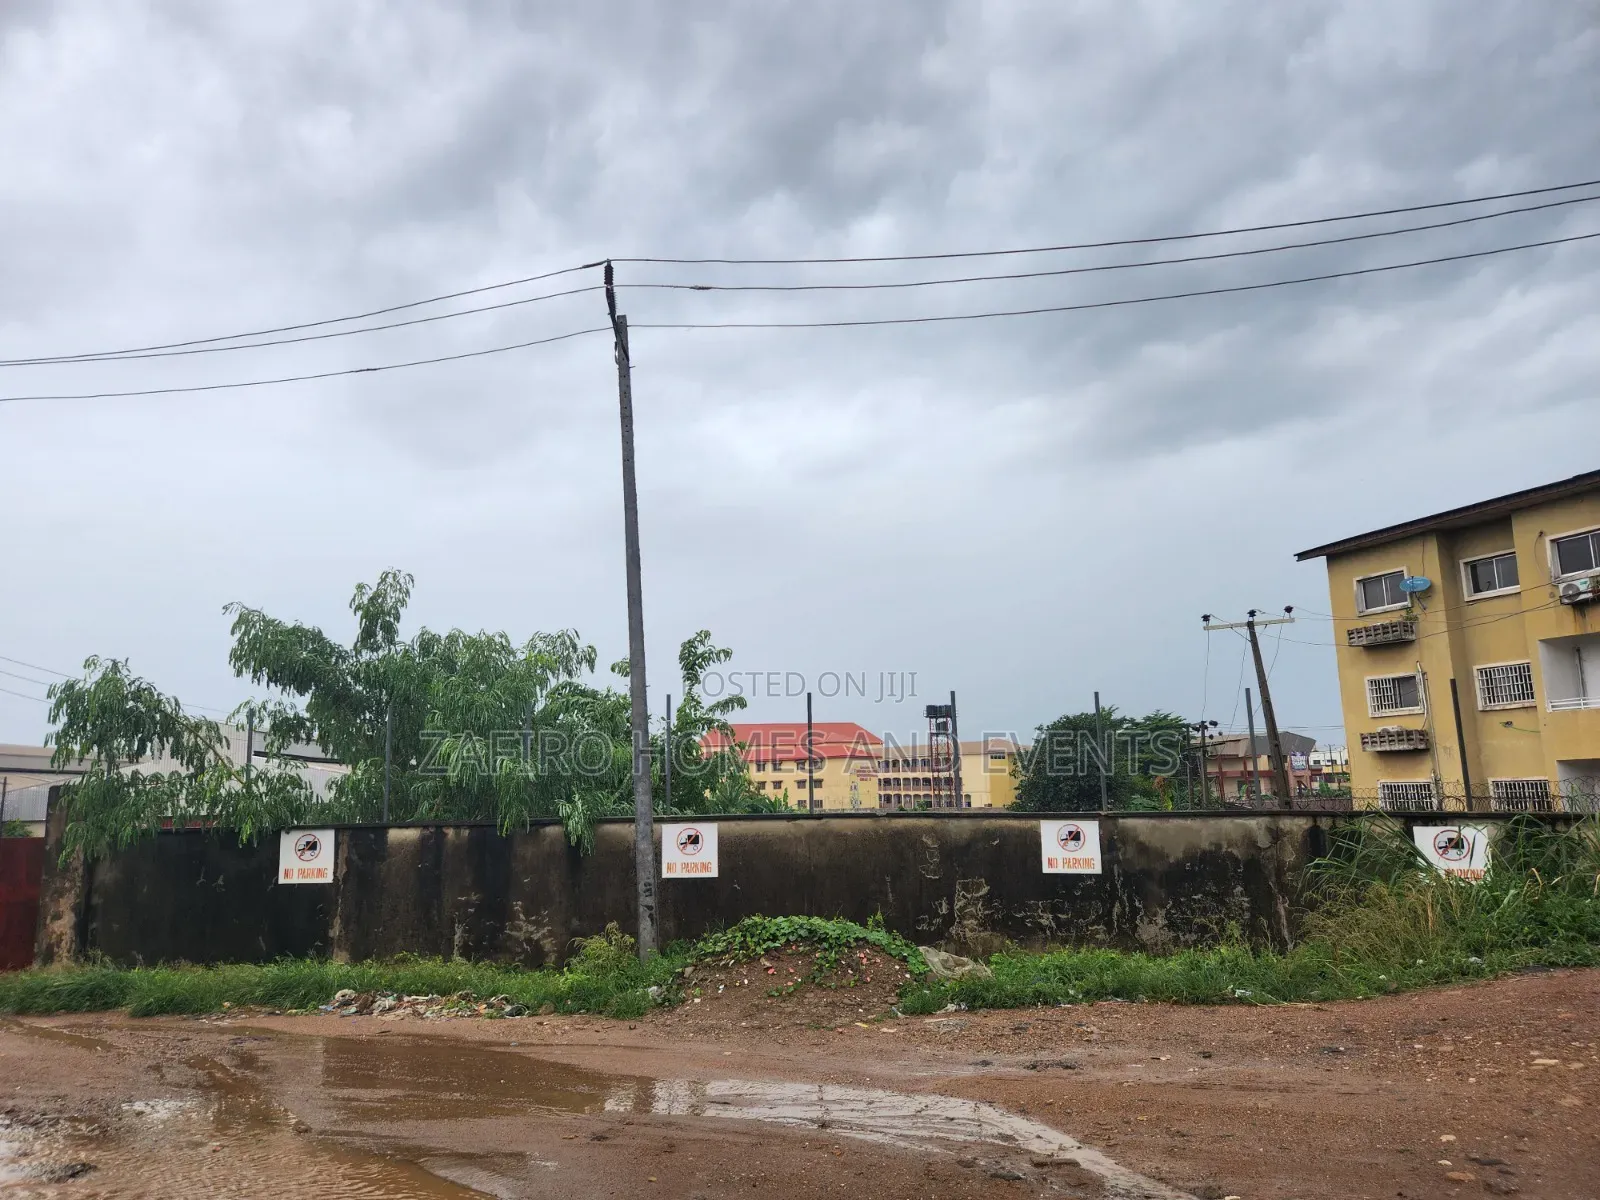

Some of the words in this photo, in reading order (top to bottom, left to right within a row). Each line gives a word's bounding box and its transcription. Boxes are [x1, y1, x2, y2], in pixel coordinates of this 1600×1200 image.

[666, 862, 677, 873] NO
[681, 862, 712, 873] PARKING
[1047, 857, 1058, 869] NO
[1062, 857, 1095, 870] PARKING
[283, 868, 294, 880] NO
[298, 867, 328, 879] PARKING
